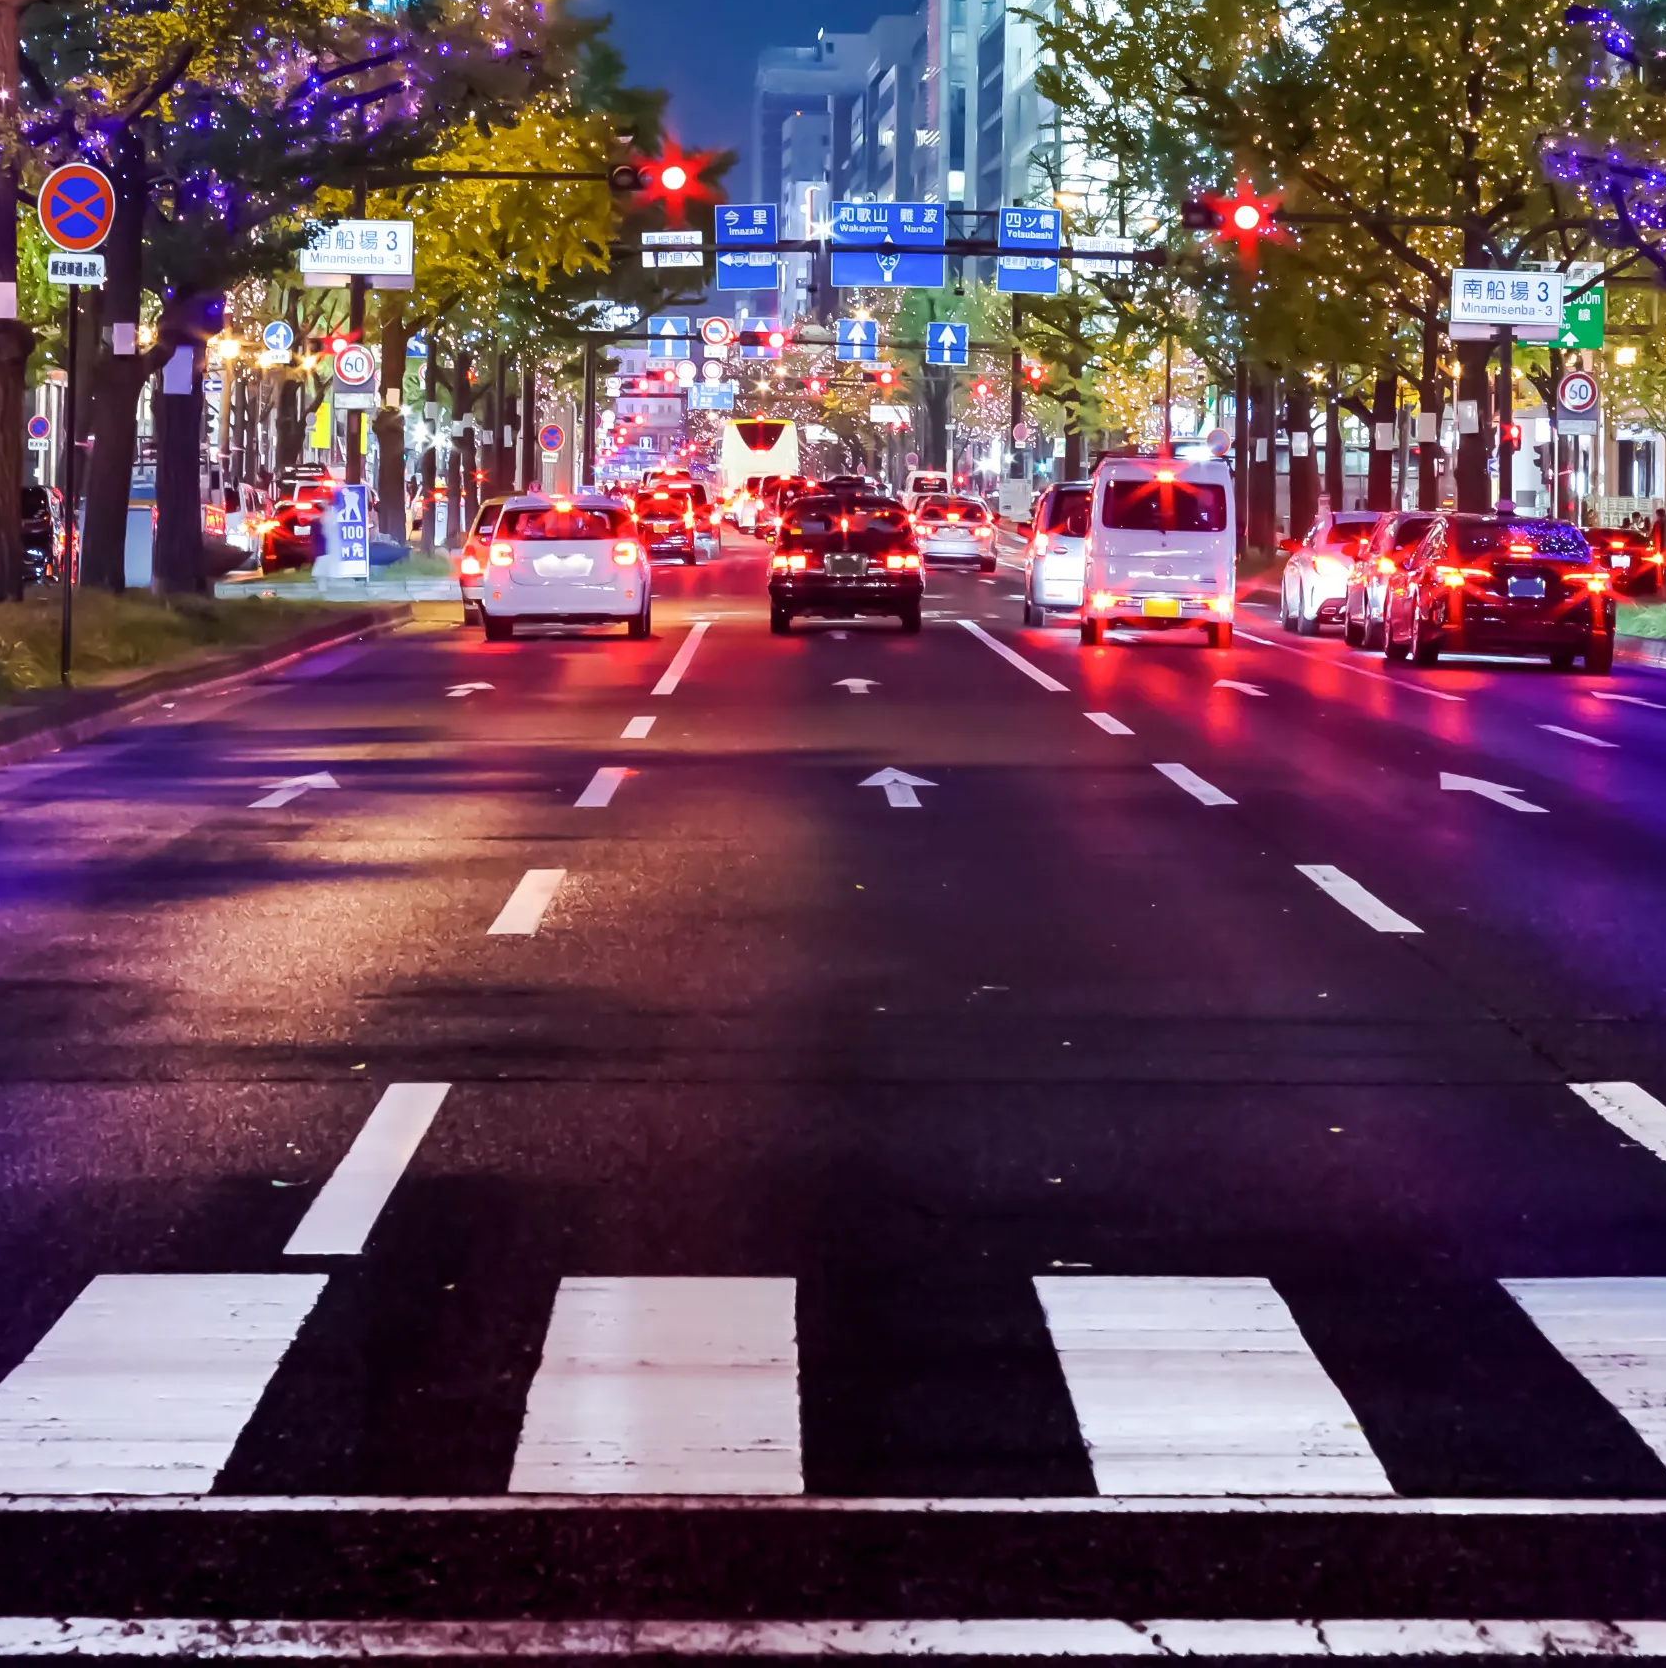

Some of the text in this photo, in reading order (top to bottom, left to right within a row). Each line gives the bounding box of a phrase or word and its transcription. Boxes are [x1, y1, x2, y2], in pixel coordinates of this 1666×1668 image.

[724, 210, 768, 226] 今里
[840, 207, 888, 223] 和歌山
[1005, 213, 1055, 230] 四ツ橋
[729, 227, 764, 236] Imazato
[839, 223, 933, 234] Wakayama Nanba
[1006, 229, 1053, 240] Yotsubashi
[310, 252, 384, 265] Minamisenba
[1461, 302, 1535, 316] Minamisenba
[343, 356, 365, 373] 60
[1569, 384, 1589, 401] 60
[342, 525, 364, 540] 100
